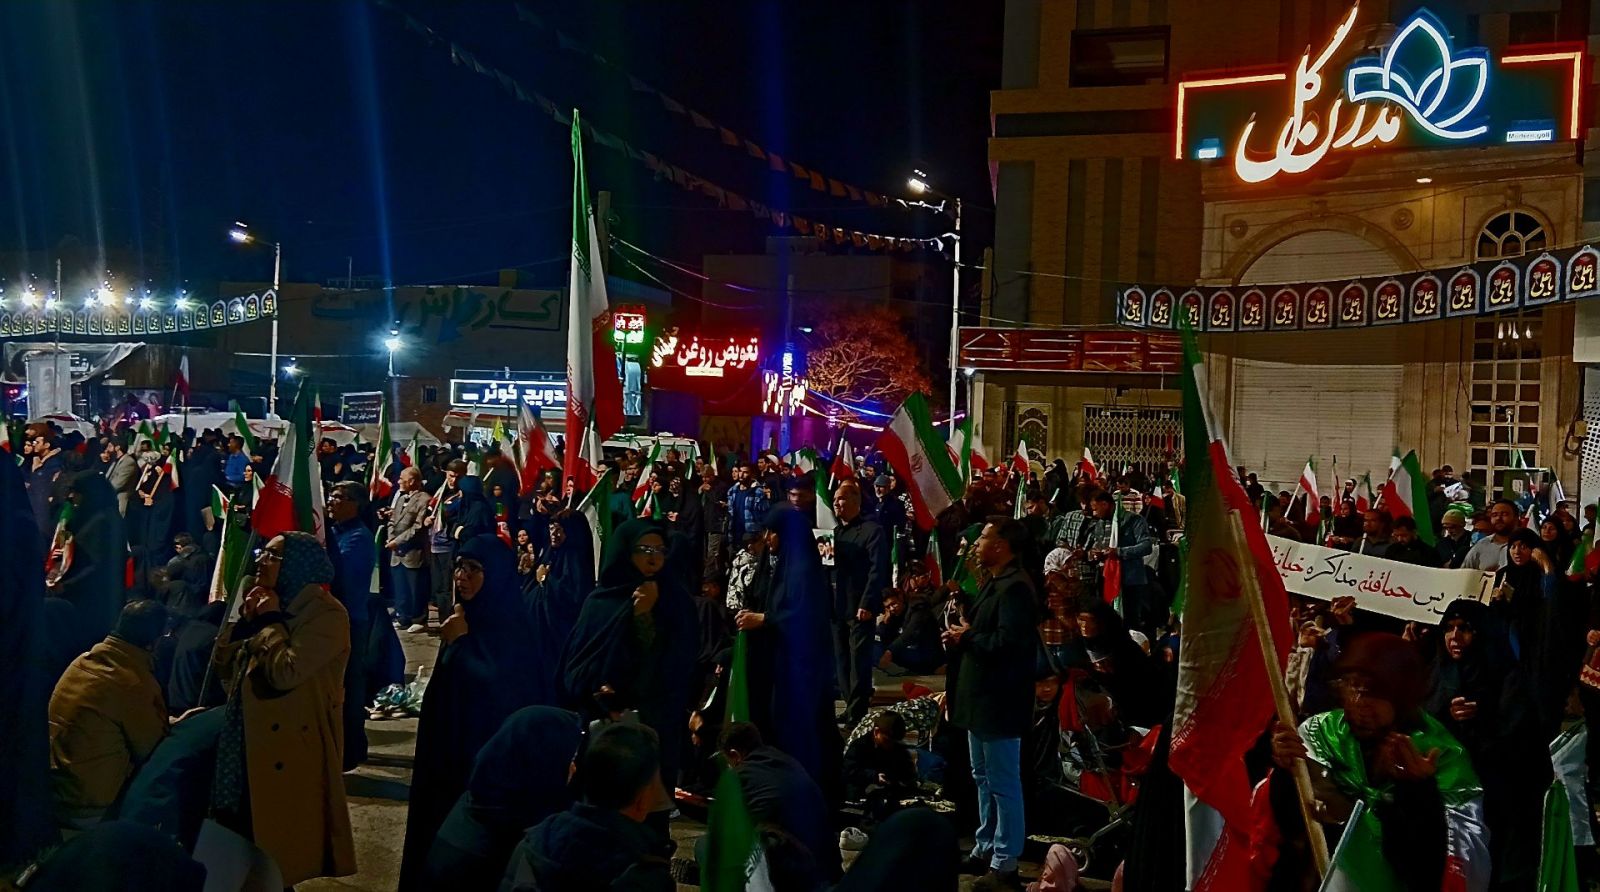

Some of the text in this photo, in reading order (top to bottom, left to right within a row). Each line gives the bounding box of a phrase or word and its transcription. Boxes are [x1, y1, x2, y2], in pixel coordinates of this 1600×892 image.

[676, 336, 712, 369] روغن
[715, 336, 759, 369] تعویض
[482, 381, 518, 404] کوثر
[1303, 552, 1358, 587] مذاکره
